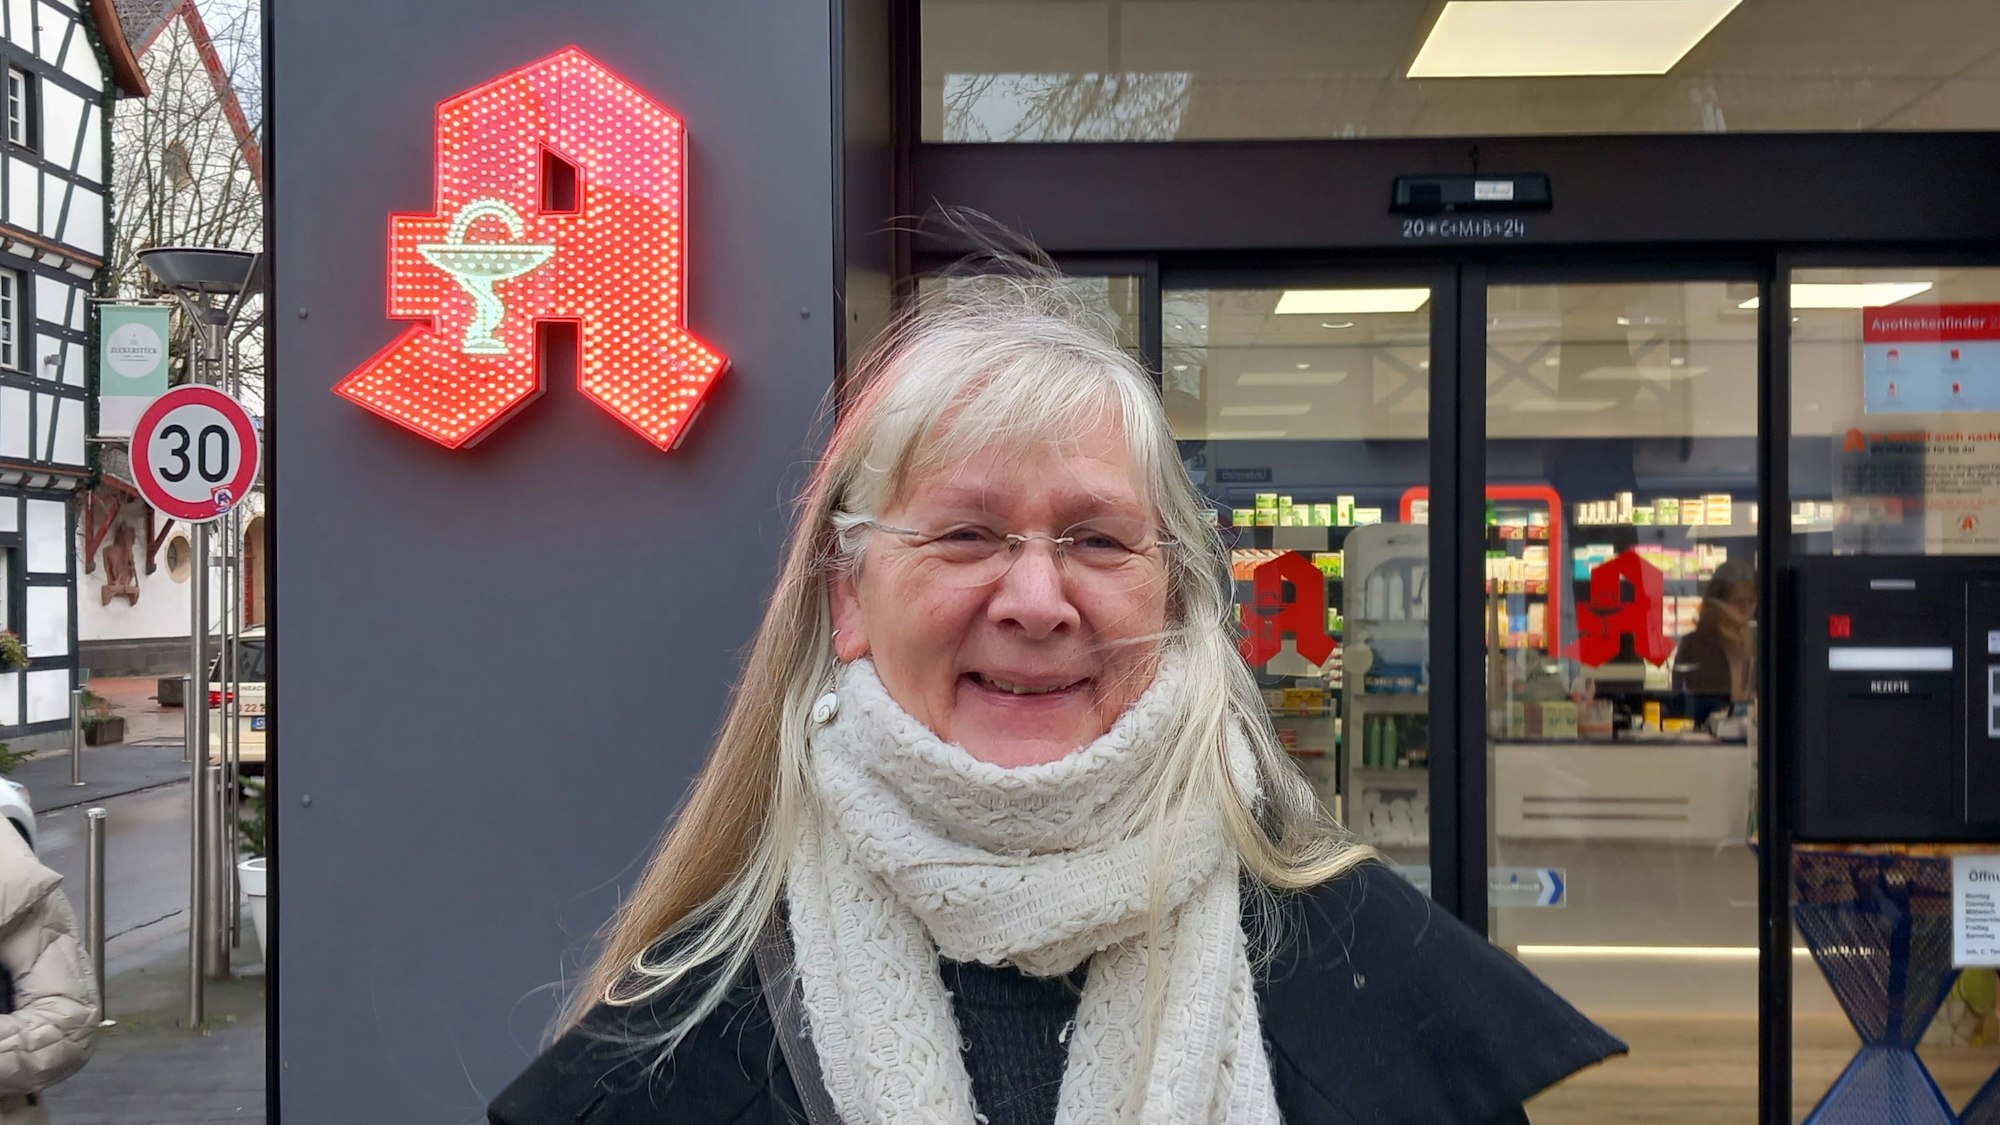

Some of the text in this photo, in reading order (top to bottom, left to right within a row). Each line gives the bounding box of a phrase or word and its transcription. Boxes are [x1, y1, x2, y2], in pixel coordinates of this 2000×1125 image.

[1871, 316, 1986, 333] Apothekenfinder
[158, 424, 230, 483] 30
[1870, 680, 1910, 693] REZEPTE
[244, 703, 257, 713] 22
